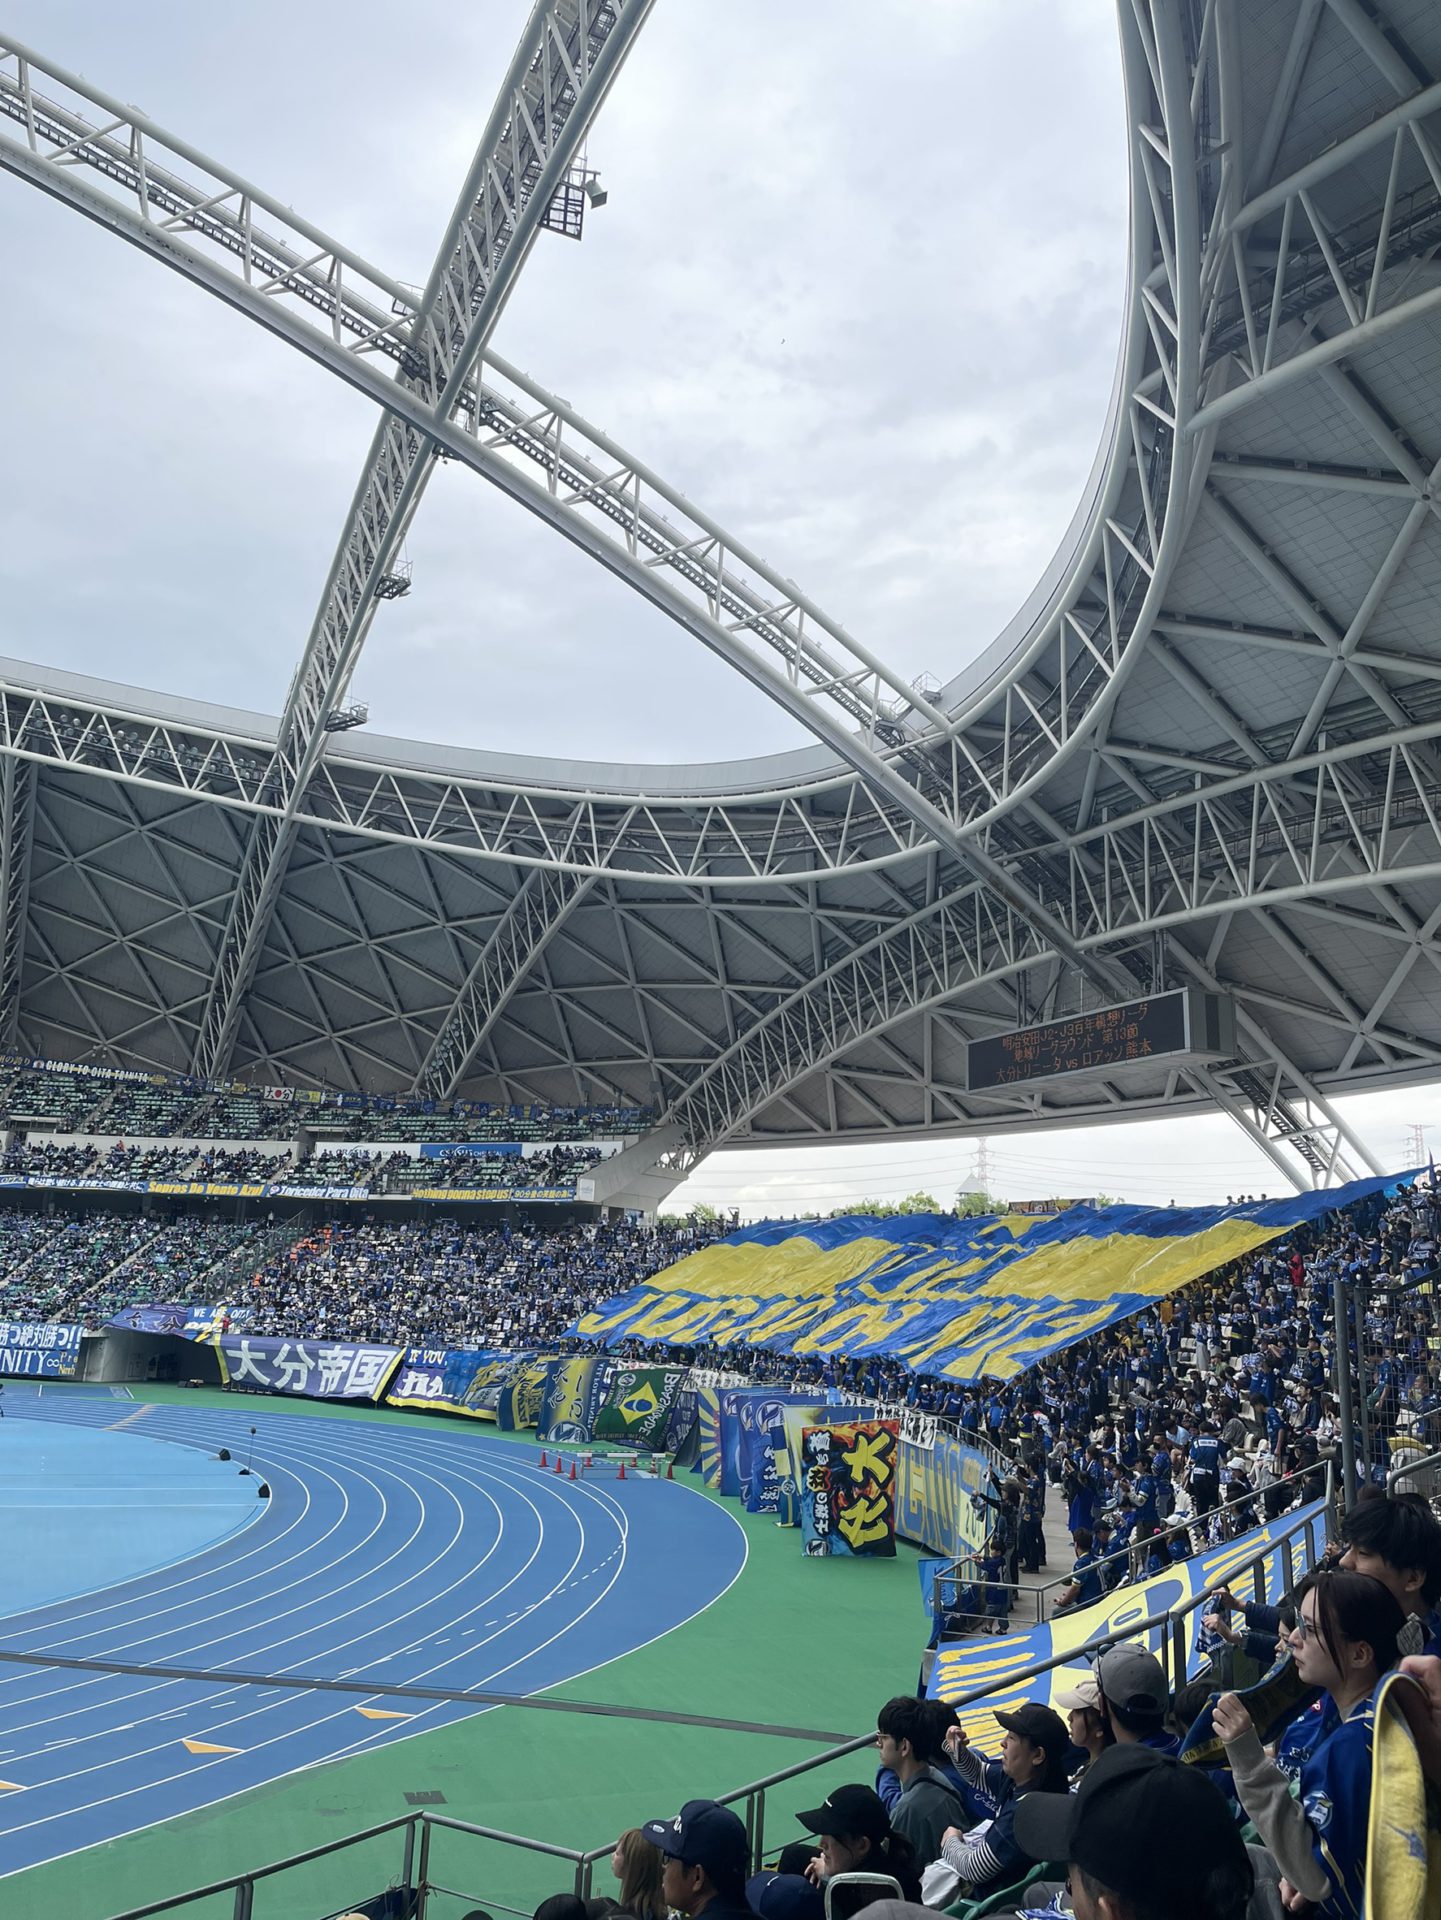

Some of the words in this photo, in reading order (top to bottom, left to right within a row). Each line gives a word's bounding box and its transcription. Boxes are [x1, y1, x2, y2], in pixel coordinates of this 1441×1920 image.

[1102, 1023, 1139, 1046] 第13節
[995, 1056, 1062, 1083] 大分トリニータ
[1066, 1058, 1078, 1069] vs
[1082, 1039, 1153, 1066] ロアッソ熊本
[46, 1060, 75, 1074] GLORY
[77, 1064, 90, 1076] TO
[91, 1066, 113, 1079] OITA
[114, 1069, 149, 1084] TRINITA
[266, 1085, 293, 1101] 大分
[326, 1187, 349, 1198] Para
[446, 1189, 475, 1200] gonna
[476, 1189, 497, 1200] stop
[194, 1307, 205, 1318] WE
[0, 1349, 50, 1375] NITY
[408, 1349, 422, 1364] IF
[226, 1340, 397, 1397] 大分帝国
